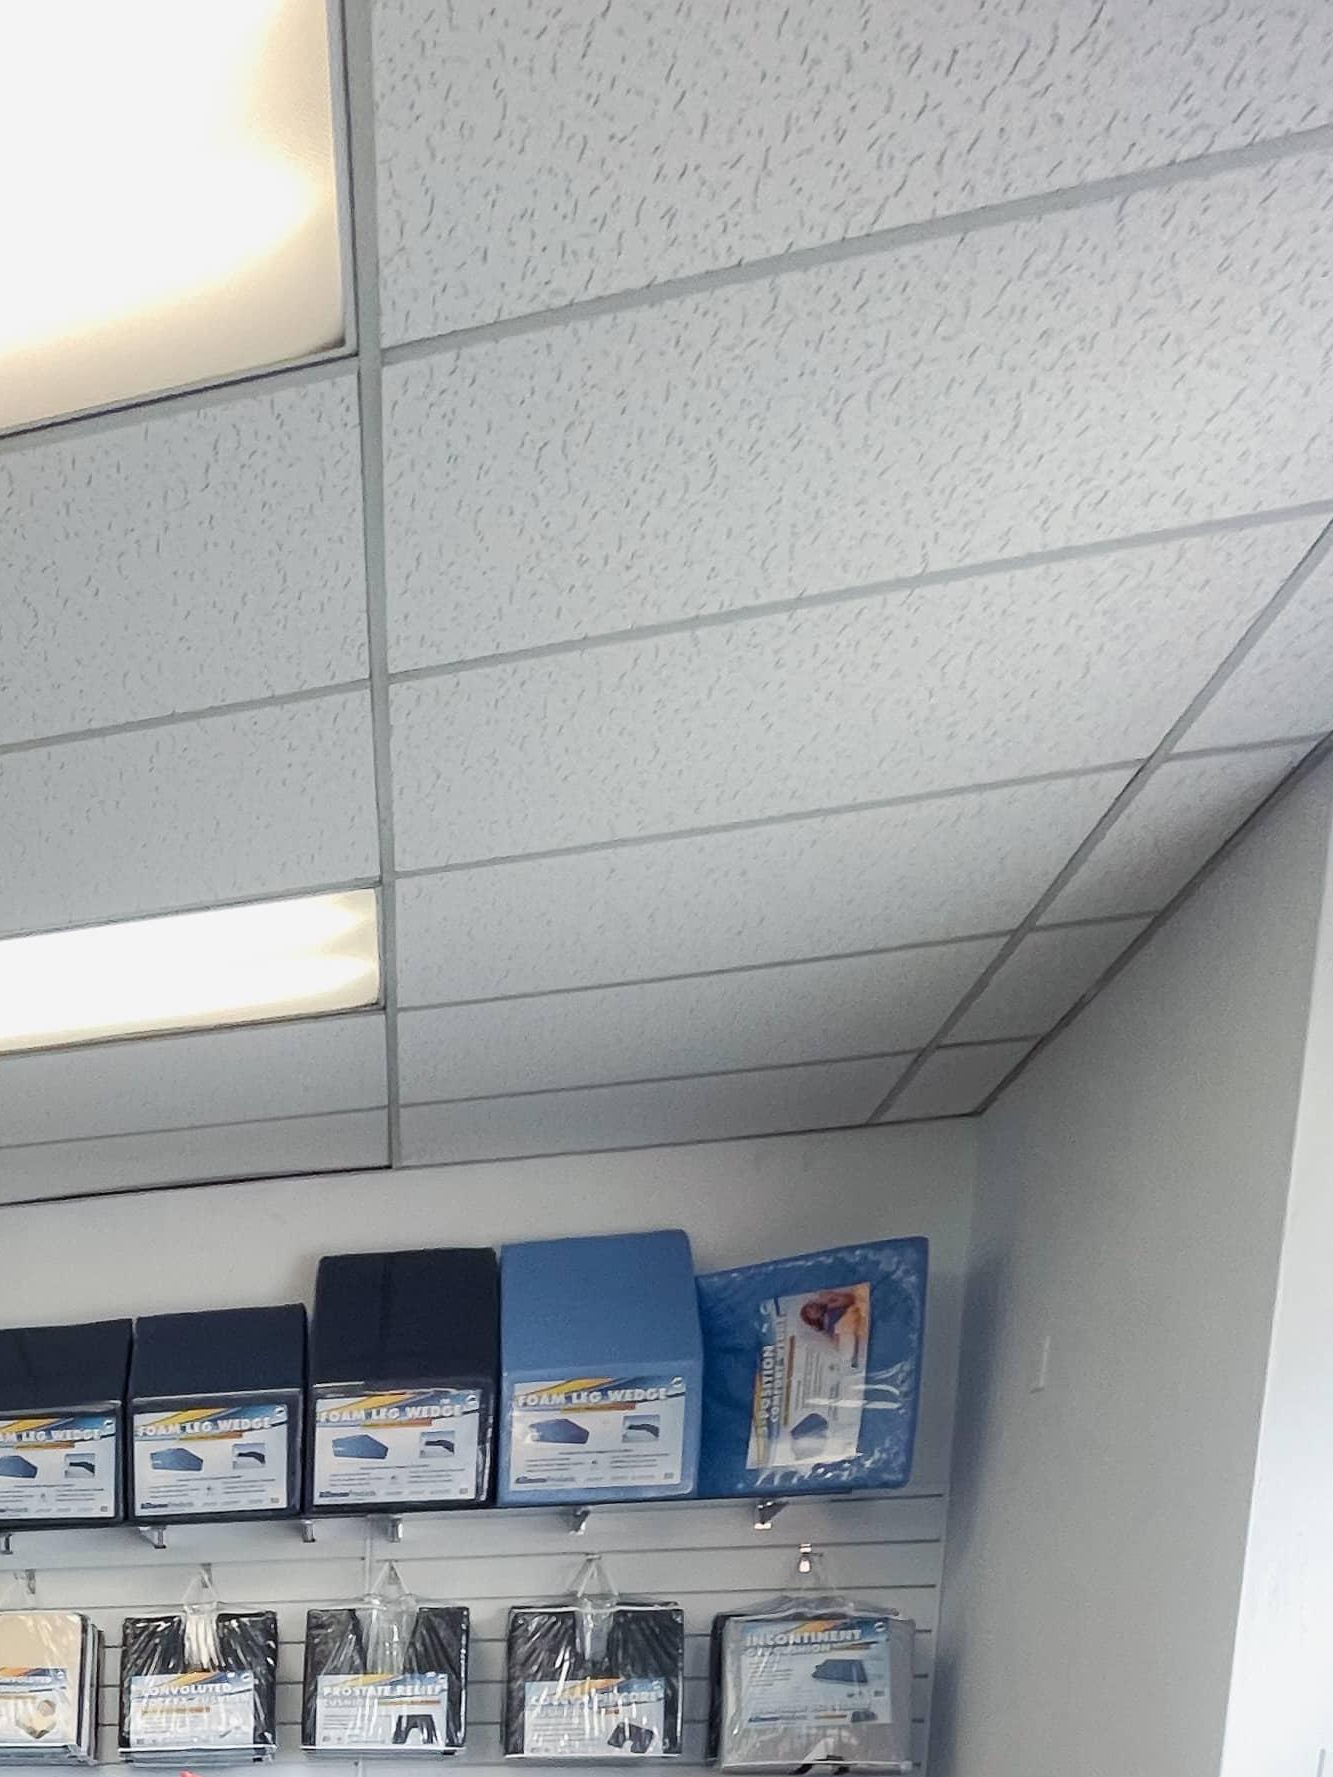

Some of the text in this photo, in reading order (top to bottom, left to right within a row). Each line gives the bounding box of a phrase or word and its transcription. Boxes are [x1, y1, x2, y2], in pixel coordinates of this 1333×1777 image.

[518, 1388, 668, 1407] FOAM LEG WEDGE
[320, 1404, 462, 1423] FOAM LEG WEDGE
[21, 1430, 46, 1442] LEG
[51, 1428, 101, 1441] WEDGE
[139, 1416, 271, 1437] FOAM LEG WEDGE
[745, 1629, 862, 1647] INCONTINENT
[323, 1683, 443, 1697] PROSTATE RELIEF
